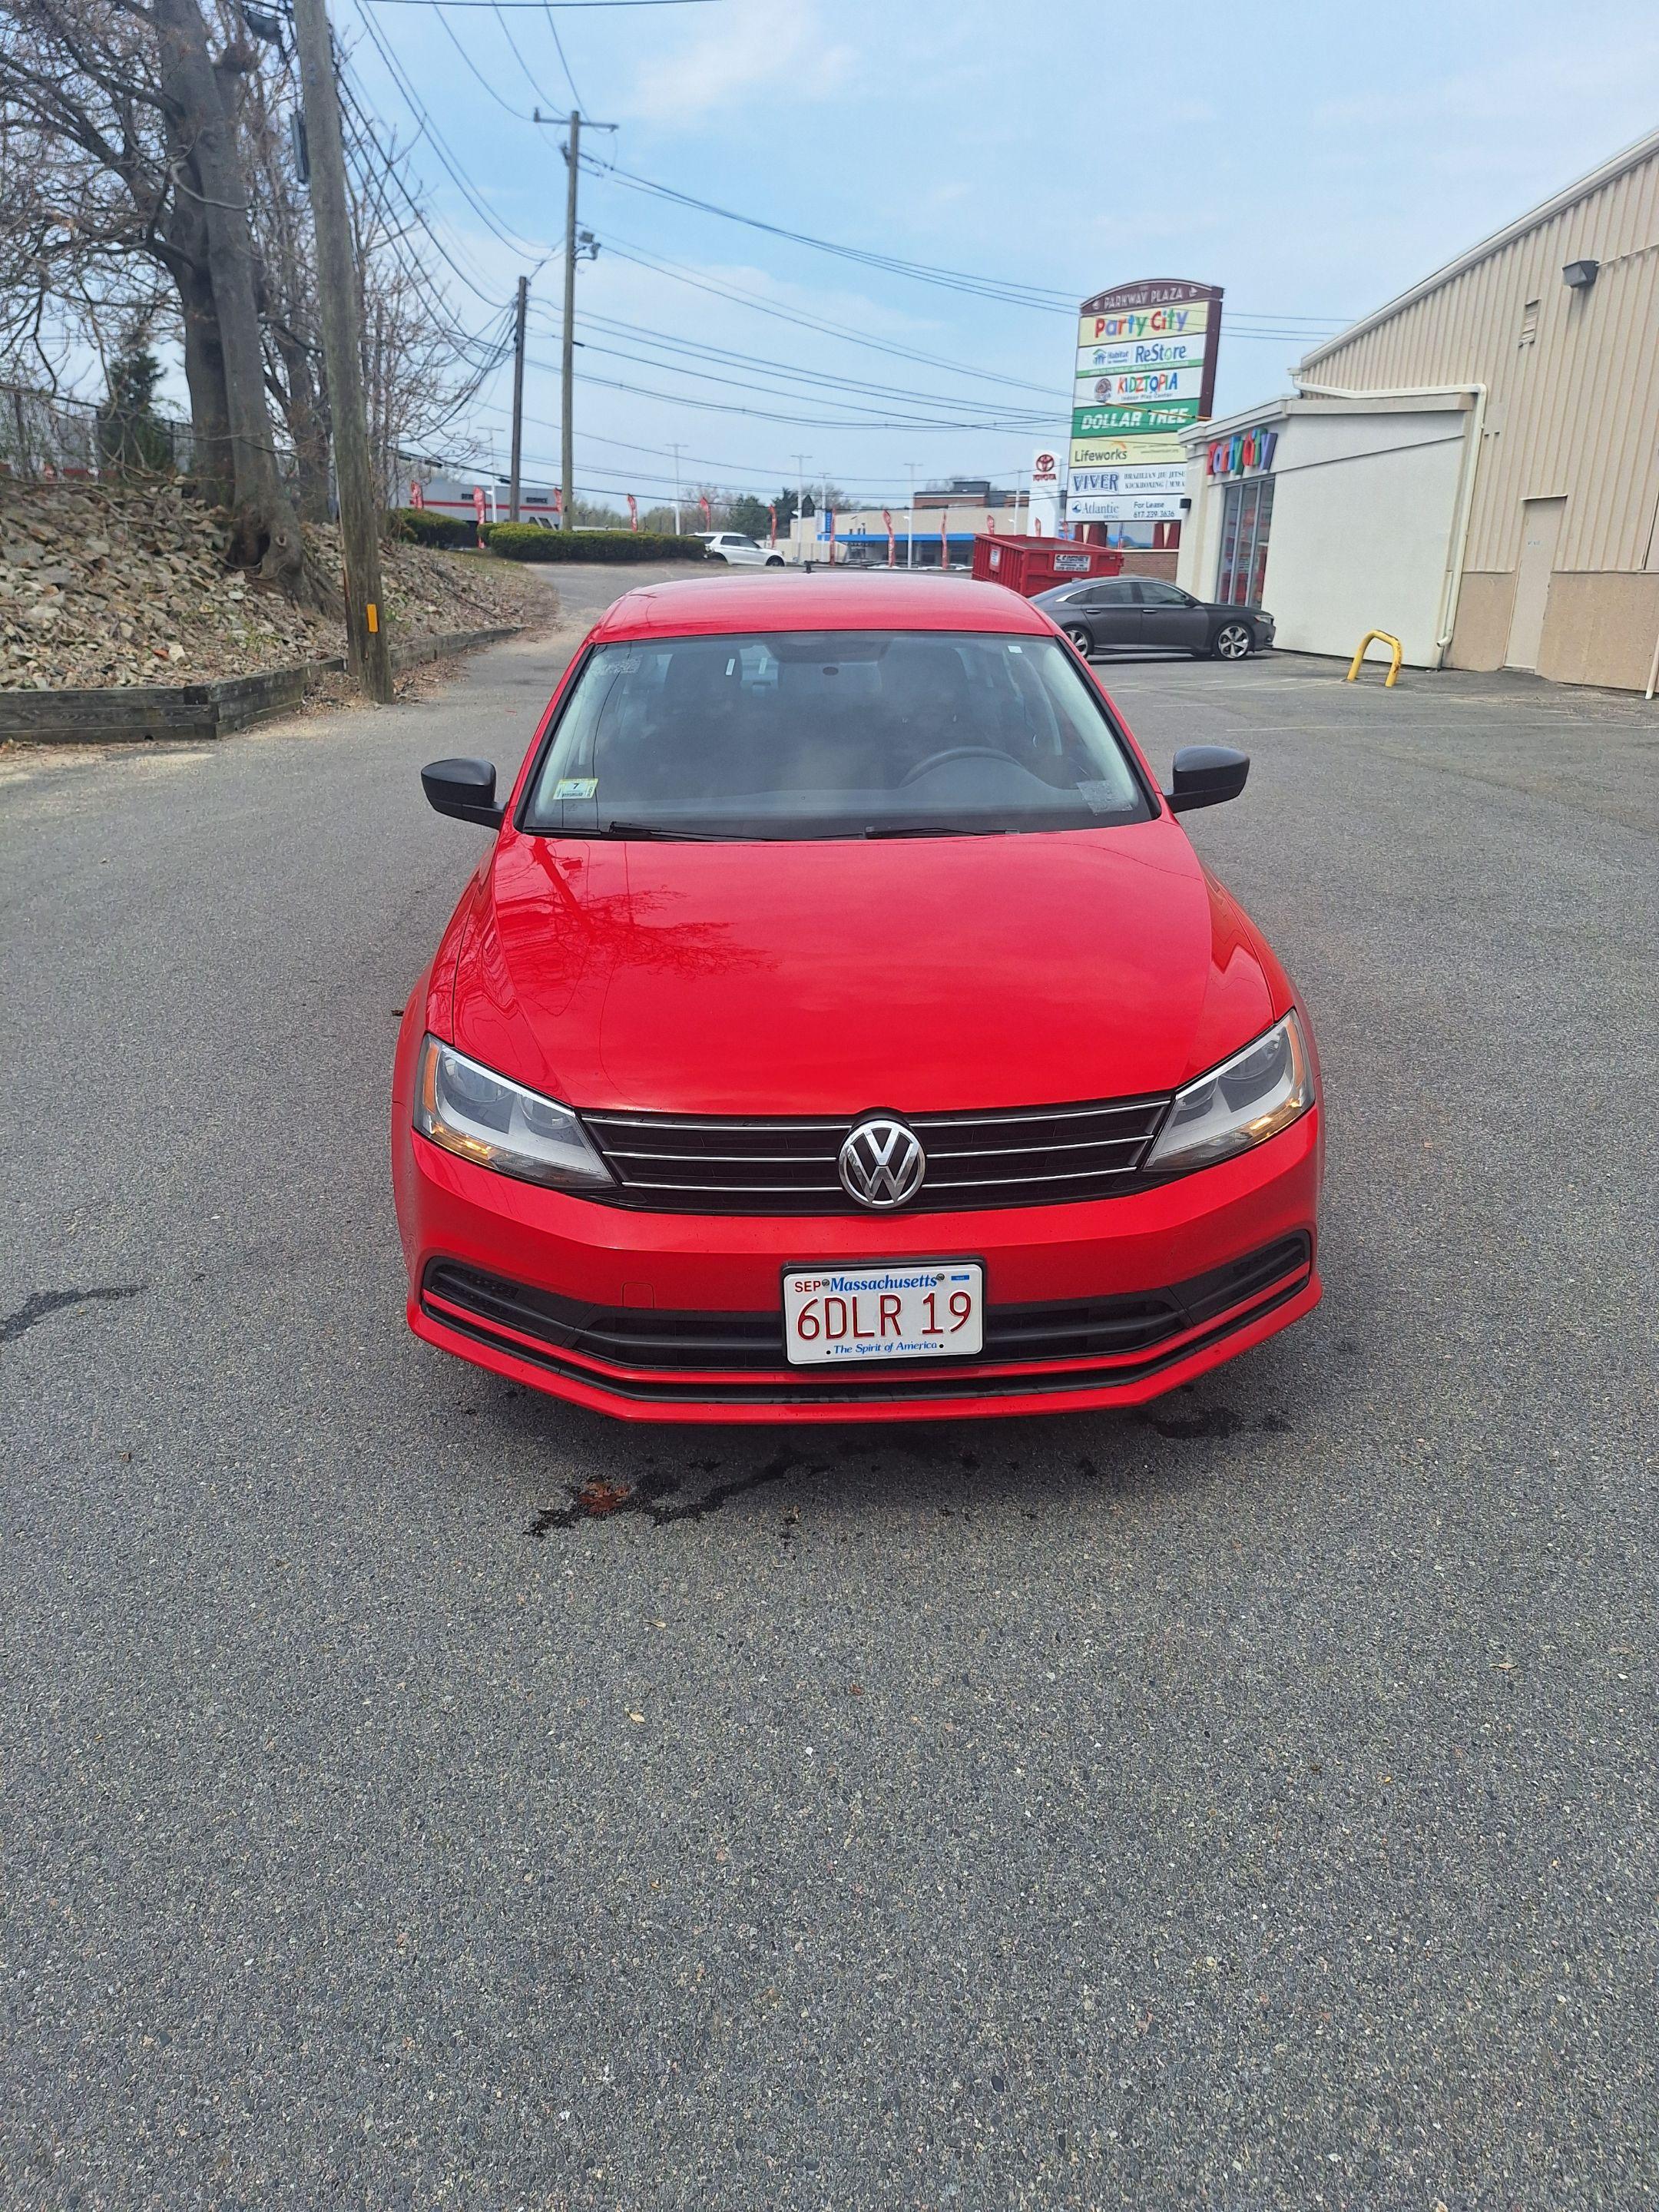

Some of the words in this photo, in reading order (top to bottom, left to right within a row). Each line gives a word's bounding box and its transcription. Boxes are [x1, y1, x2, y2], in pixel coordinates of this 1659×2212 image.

[1104, 292, 1147, 308] PARKWAY
[1151, 287, 1183, 303] PLAZA
[1094, 314, 1147, 338] Party
[1151, 308, 1188, 332] City
[1108, 350, 1128, 359] Habitat
[1135, 343, 1187, 363] ReStore
[1118, 372, 1178, 394] KIDZTOPIA
[1081, 411, 1142, 430] DOLLAR
[1148, 408, 1189, 426] TREE
[1075, 449, 1128, 462] Lifeworks
[1072, 472, 1120, 492] VIVER
[1082, 502, 1120, 514] Atlantic
[794, 1280, 821, 1293] SEP
[830, 1274, 939, 1292] Massachusetts
[797, 1293, 902, 1341] 6DLR
[922, 1291, 972, 1335] 19
[833, 1345, 853, 1354] The
[856, 1343, 881, 1355] Spirit
[884, 1342, 892, 1353] of
[896, 1341, 938, 1351] America
